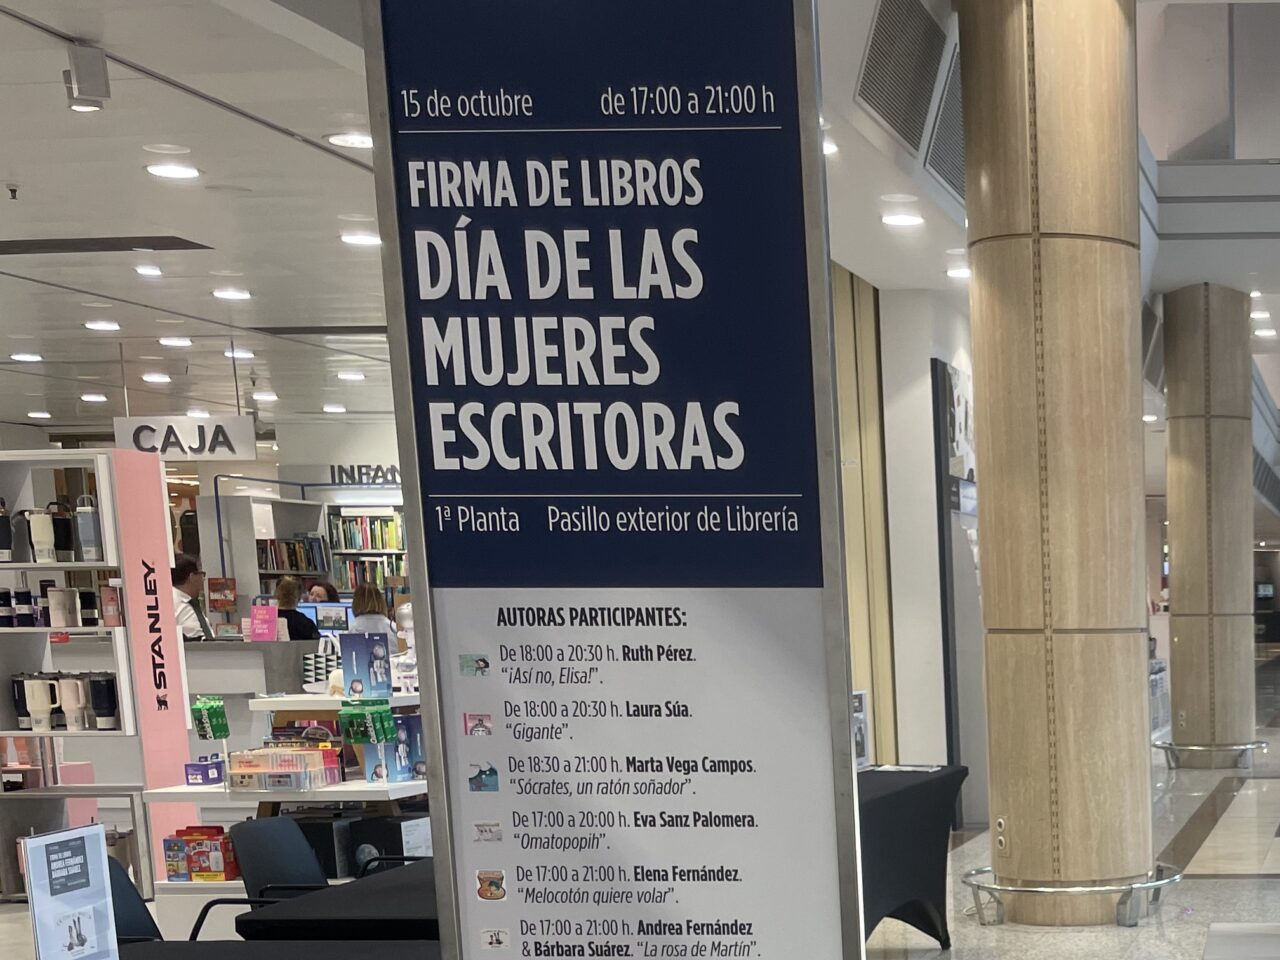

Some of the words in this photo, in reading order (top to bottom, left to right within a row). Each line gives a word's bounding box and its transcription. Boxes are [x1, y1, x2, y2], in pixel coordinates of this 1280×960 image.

[401, 89, 421, 118] 15
[426, 89, 452, 118] de
[457, 88, 533, 117] octubre
[600, 87, 626, 116] de
[630, 86, 682, 115] 17:00
[686, 93, 700, 114] a
[705, 85, 757, 114] 21:00
[761, 85, 775, 113] h
[408, 160, 517, 208] FIRMA
[526, 159, 571, 207] DE
[580, 158, 703, 206] LIBROS
[414, 214, 512, 300] DÍA
[524, 229, 594, 299] DE
[608, 228, 703, 299] LAS
[421, 315, 661, 387] MUJERES
[132, 424, 235, 455] CAJA
[428, 401, 745, 471] ESCRITORAS
[458, 507, 520, 532] Planta
[548, 505, 610, 532] Pasillo
[616, 506, 690, 532] exterior
[697, 506, 721, 532] de
[726, 505, 799, 532] Librería
[141, 559, 169, 690] STANLEY
[497, 608, 566, 627] AUTORAS
[569, 606, 687, 627] PARTICIPANTES:
[499, 645, 516, 662] De
[520, 645, 552, 662] 18:00
[556, 650, 564, 661] a
[567, 645, 602, 662] 20:30
[606, 645, 619, 661] h.
[622, 645, 653, 661] Ruth
[657, 645, 696, 662] Pérez.
[508, 756, 525, 773] De
[528, 756, 560, 773] 18:30
[563, 761, 571, 773] a
[574, 756, 607, 773] 21:00
[611, 756, 623, 773] h.
[626, 757, 663, 773] Marta
[666, 757, 698, 776] Vega
[701, 757, 756, 776] Campos.
